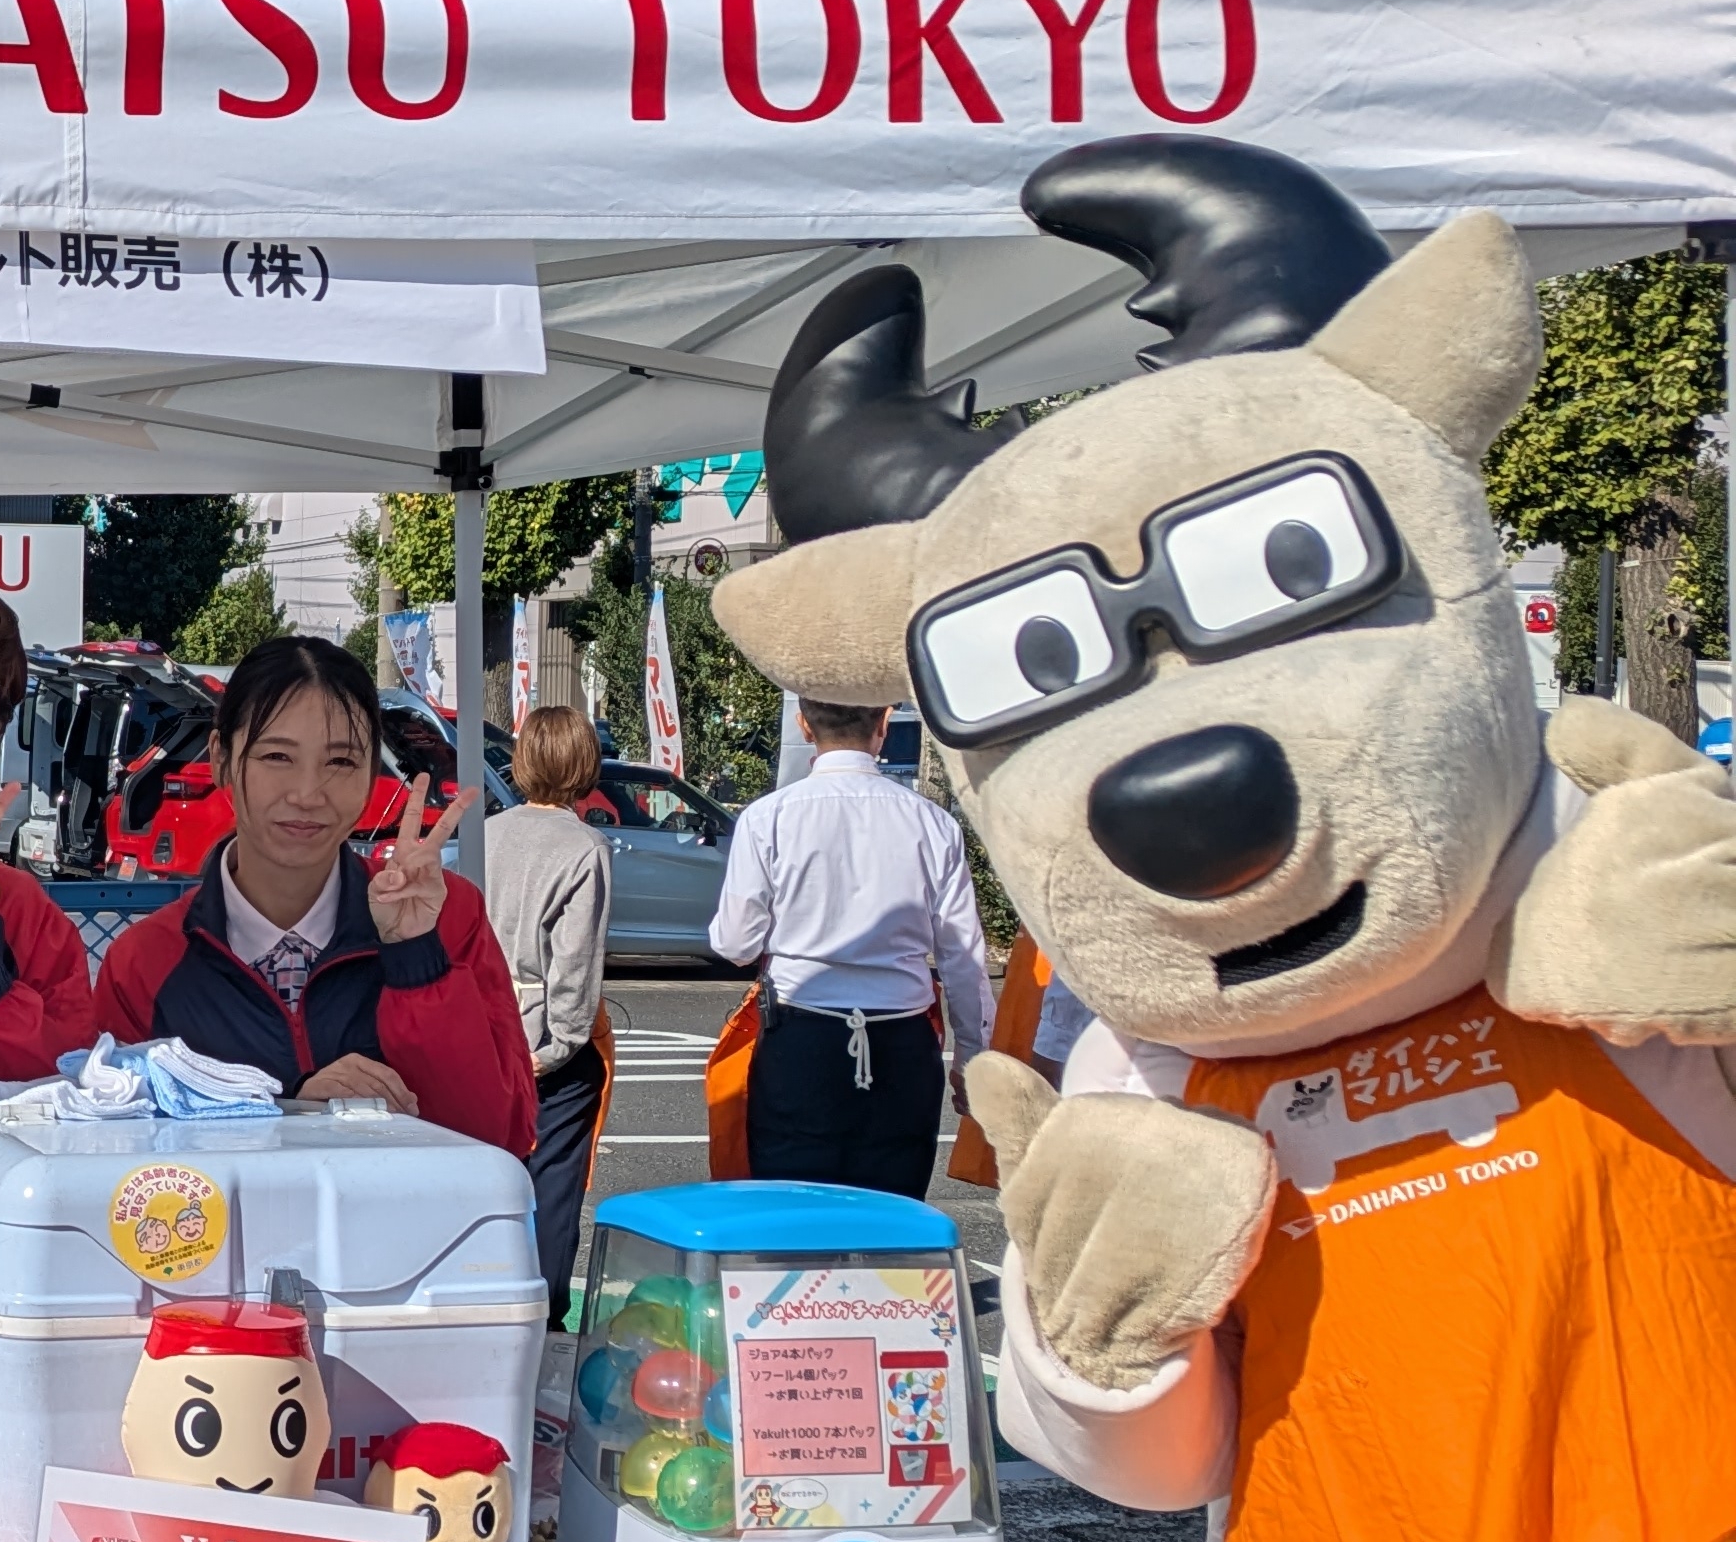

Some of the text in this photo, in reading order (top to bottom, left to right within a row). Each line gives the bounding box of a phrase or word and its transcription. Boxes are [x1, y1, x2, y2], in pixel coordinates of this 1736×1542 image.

[1345, 1015, 1496, 1077] ダイハツ
[1346, 1048, 1503, 1105] マルシェ
[1329, 1150, 1539, 1225] DAIHATSU TOKYO
[752, 1427, 821, 1439] Yakult1000
